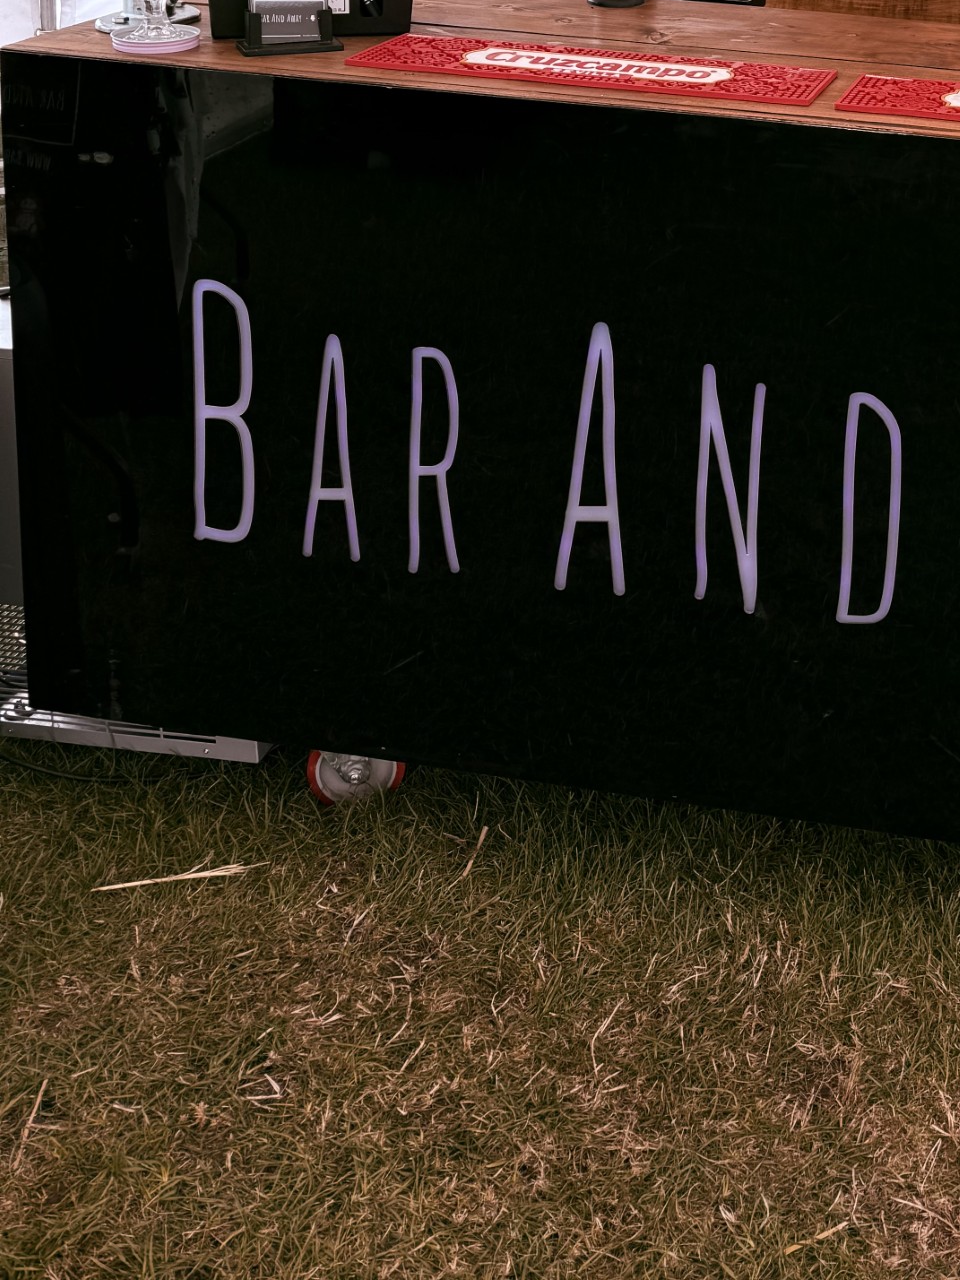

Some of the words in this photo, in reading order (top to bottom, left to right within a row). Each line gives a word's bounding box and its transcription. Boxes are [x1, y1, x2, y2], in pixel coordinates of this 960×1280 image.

[260, 15, 270, 23] AR
[484, 50, 713, 80] Cruzcampo
[192, 278, 460, 574] BAR
[553, 320, 903, 624] AND
